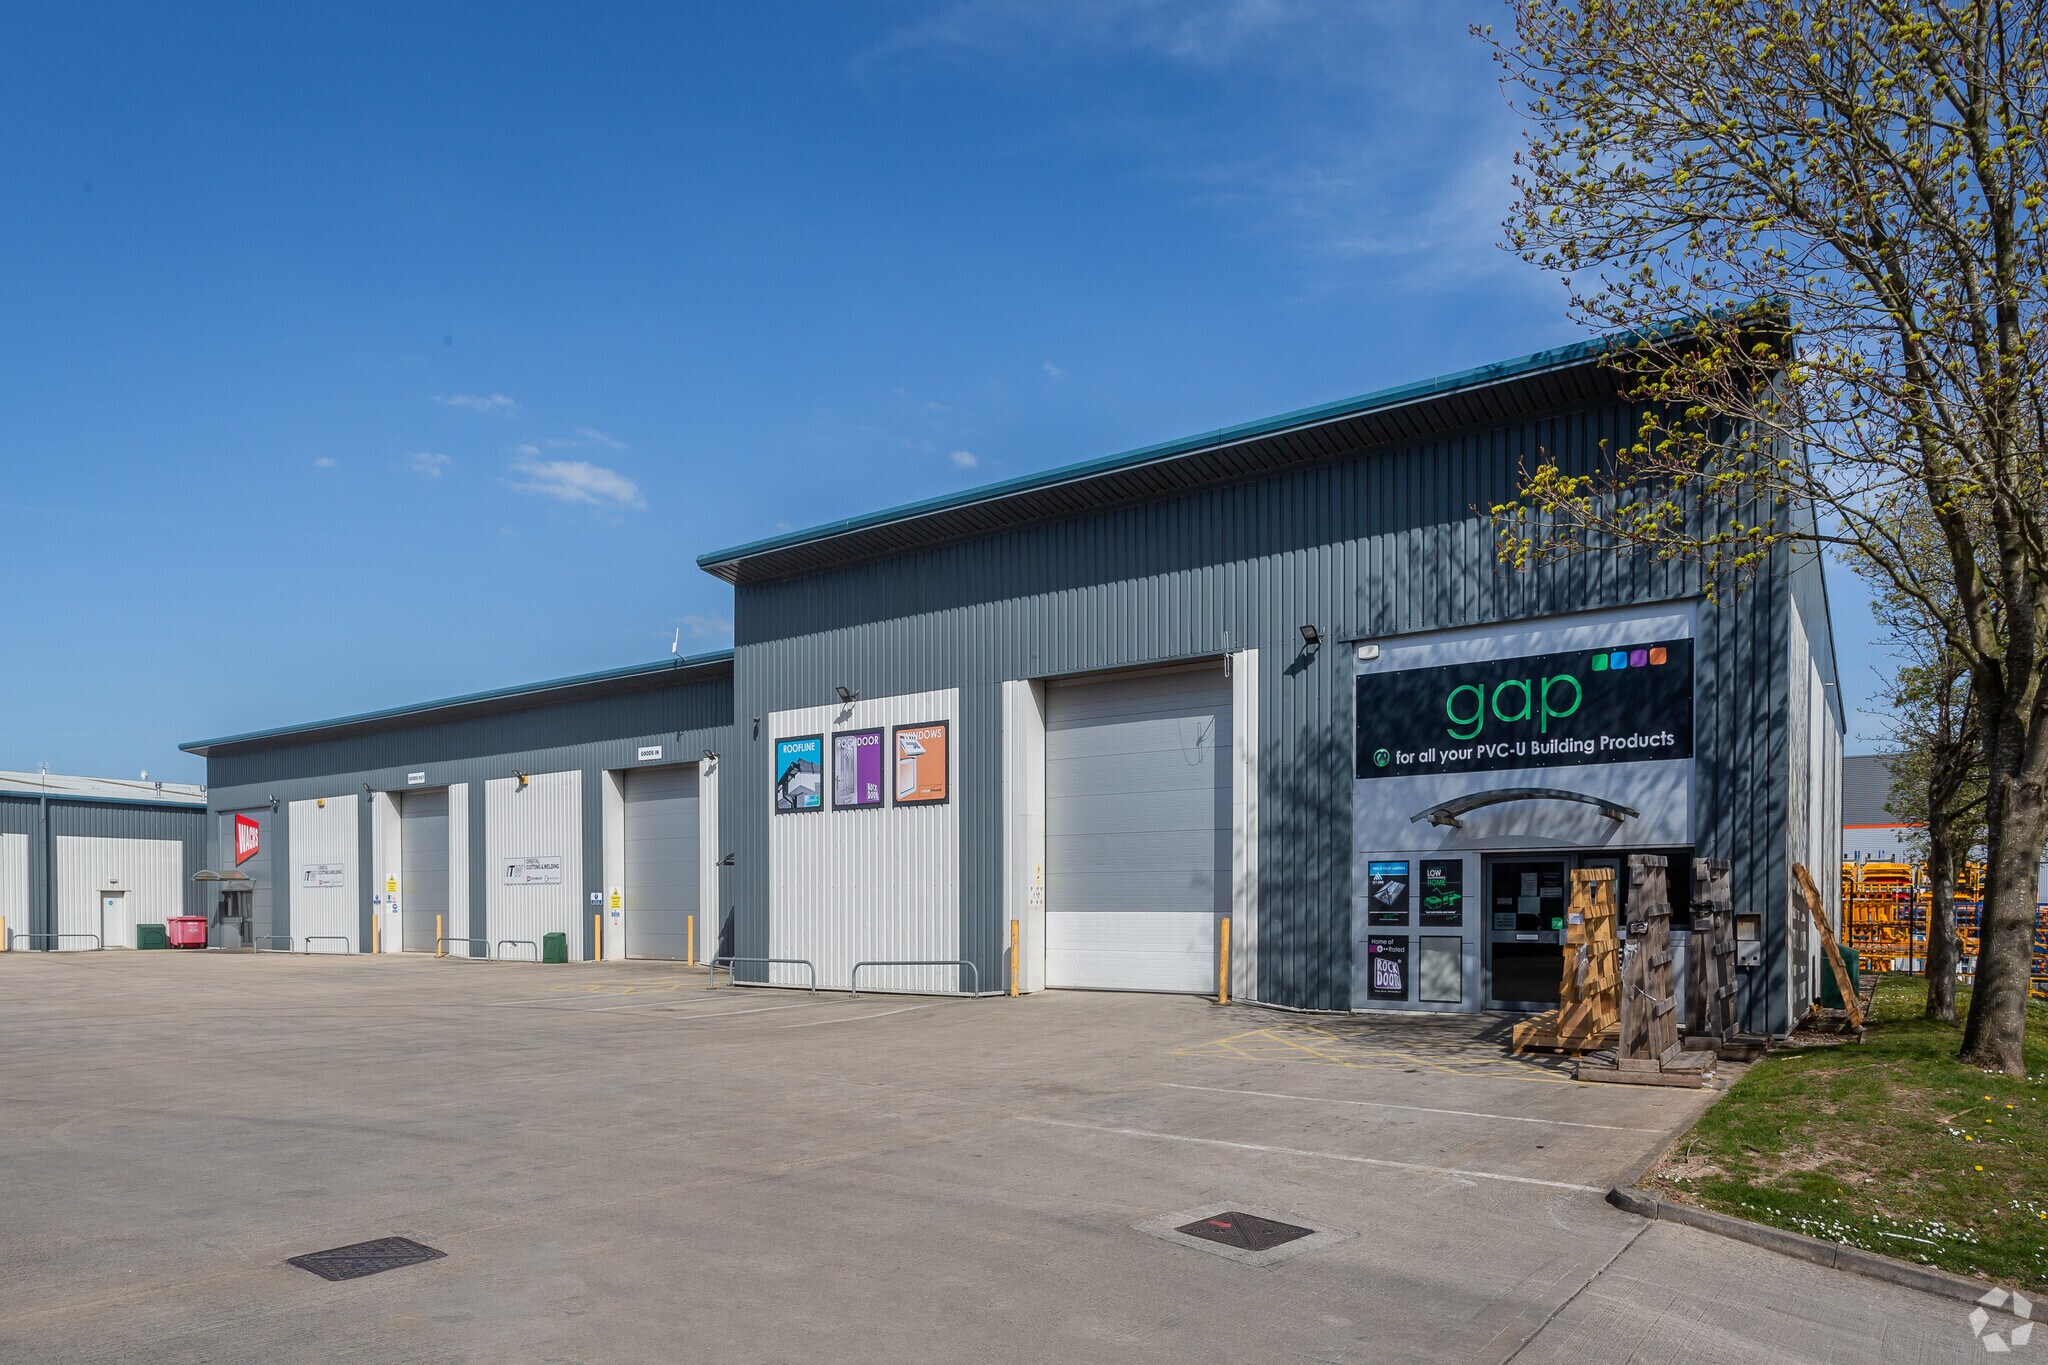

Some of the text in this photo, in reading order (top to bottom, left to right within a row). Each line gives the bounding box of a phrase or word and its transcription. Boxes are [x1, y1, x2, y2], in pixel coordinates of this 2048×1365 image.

[1446, 674, 1583, 740] gap
[783, 742, 815, 754] ROOFLINE
[1396, 730, 1675, 765] for all your PVC-U Building Products
[506, 865, 523, 877] ITW
[1376, 959, 1399, 974] ROCK
[1376, 970, 1401, 987] DOOR
